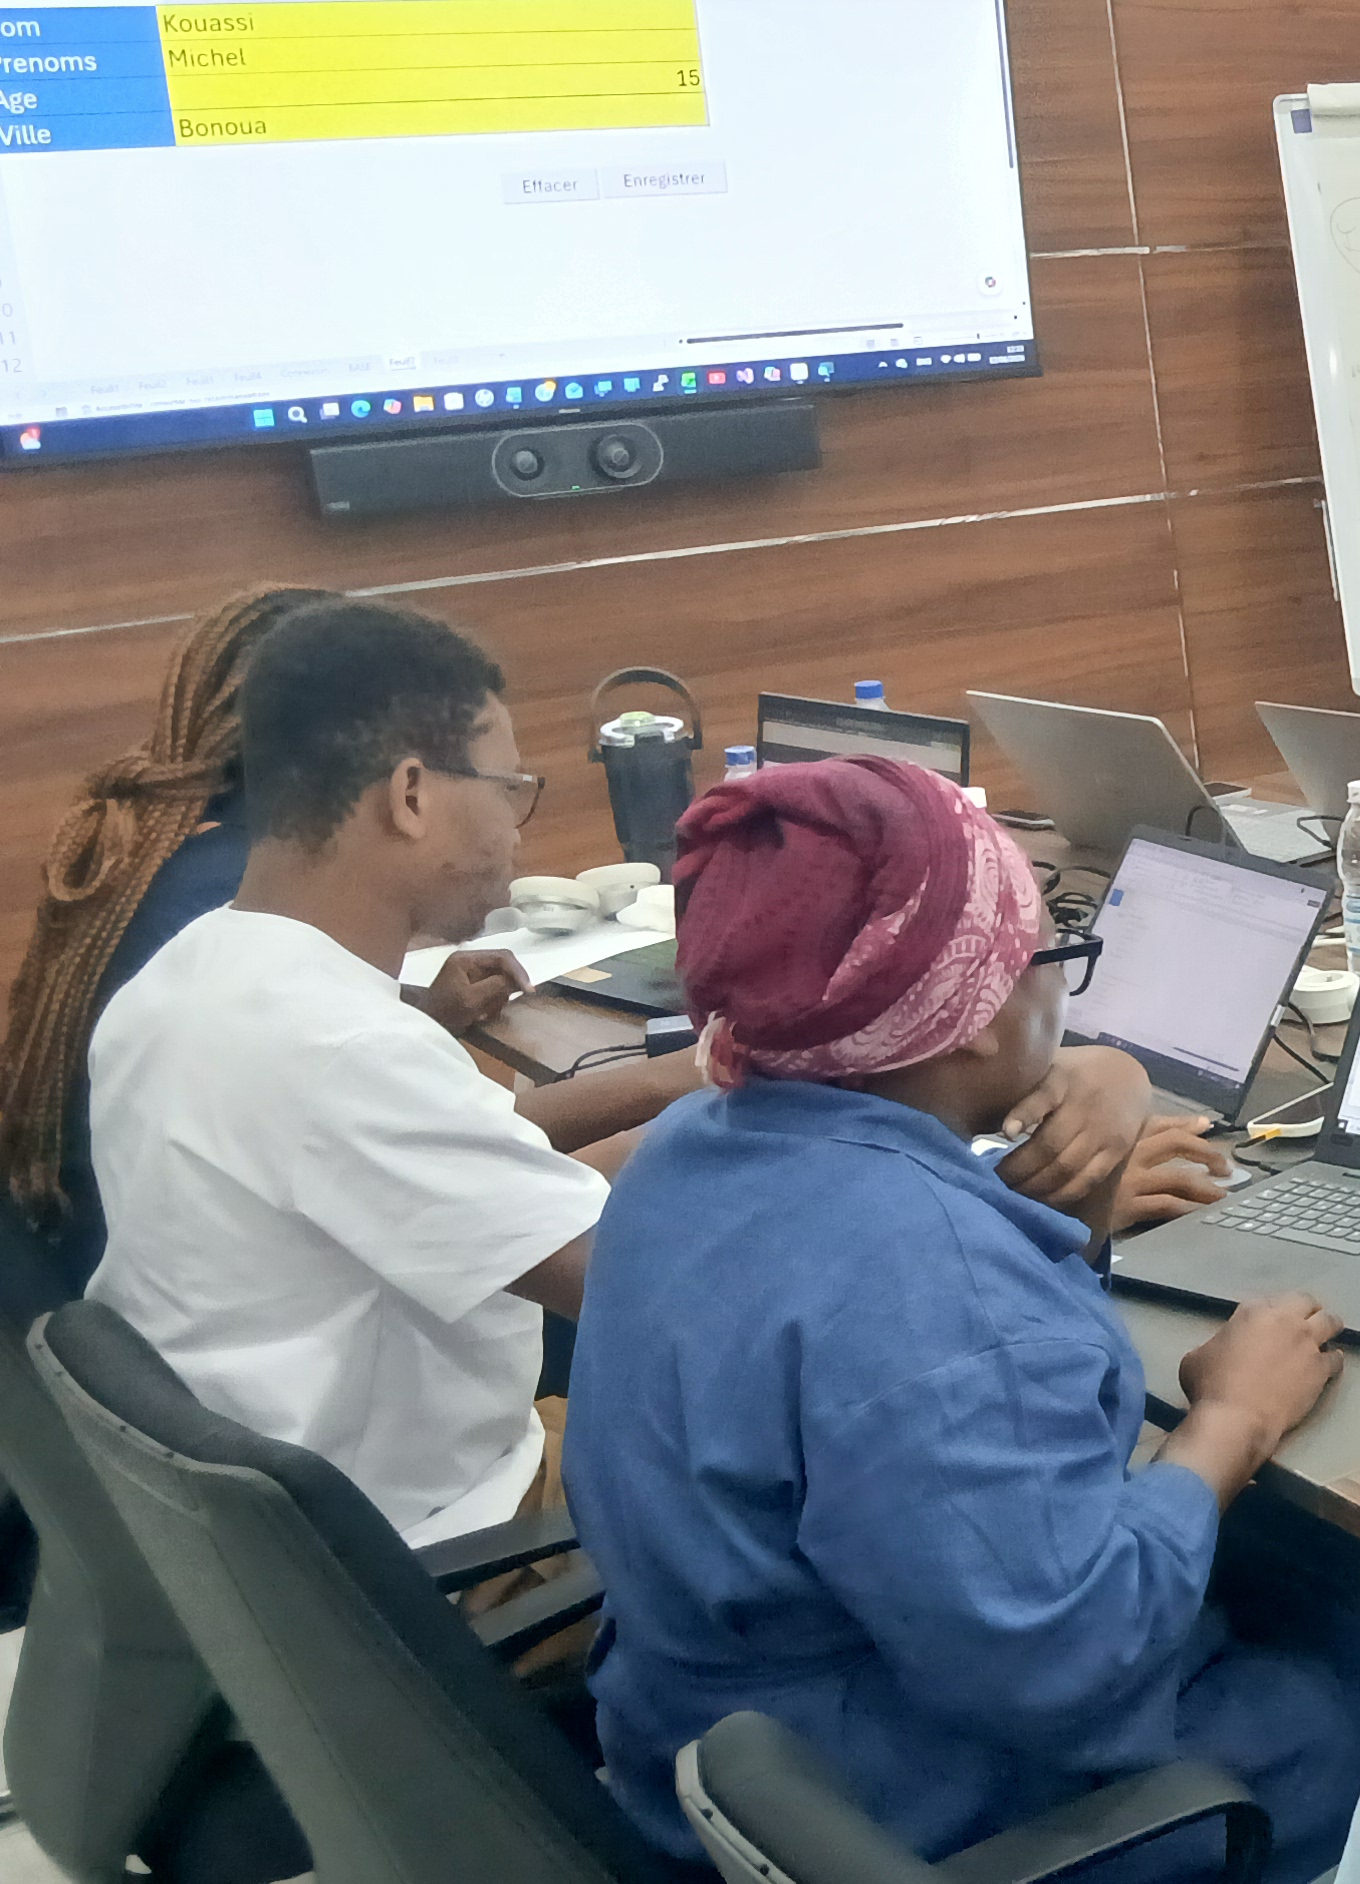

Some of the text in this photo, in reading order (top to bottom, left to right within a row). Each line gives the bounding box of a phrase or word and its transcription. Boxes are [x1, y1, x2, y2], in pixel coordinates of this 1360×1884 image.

[0, 20, 41, 37] om
[163, 12, 254, 33] Kouassi
[0, 56, 97, 74] renoms
[168, 48, 247, 68] Michel
[677, 69, 701, 87] 15
[0, 124, 51, 146] Ville
[179, 118, 267, 138] Bonoua
[522, 179, 578, 194] Effacer
[623, 172, 705, 190] Enregistrer
[1, 358, 22, 373] 12
